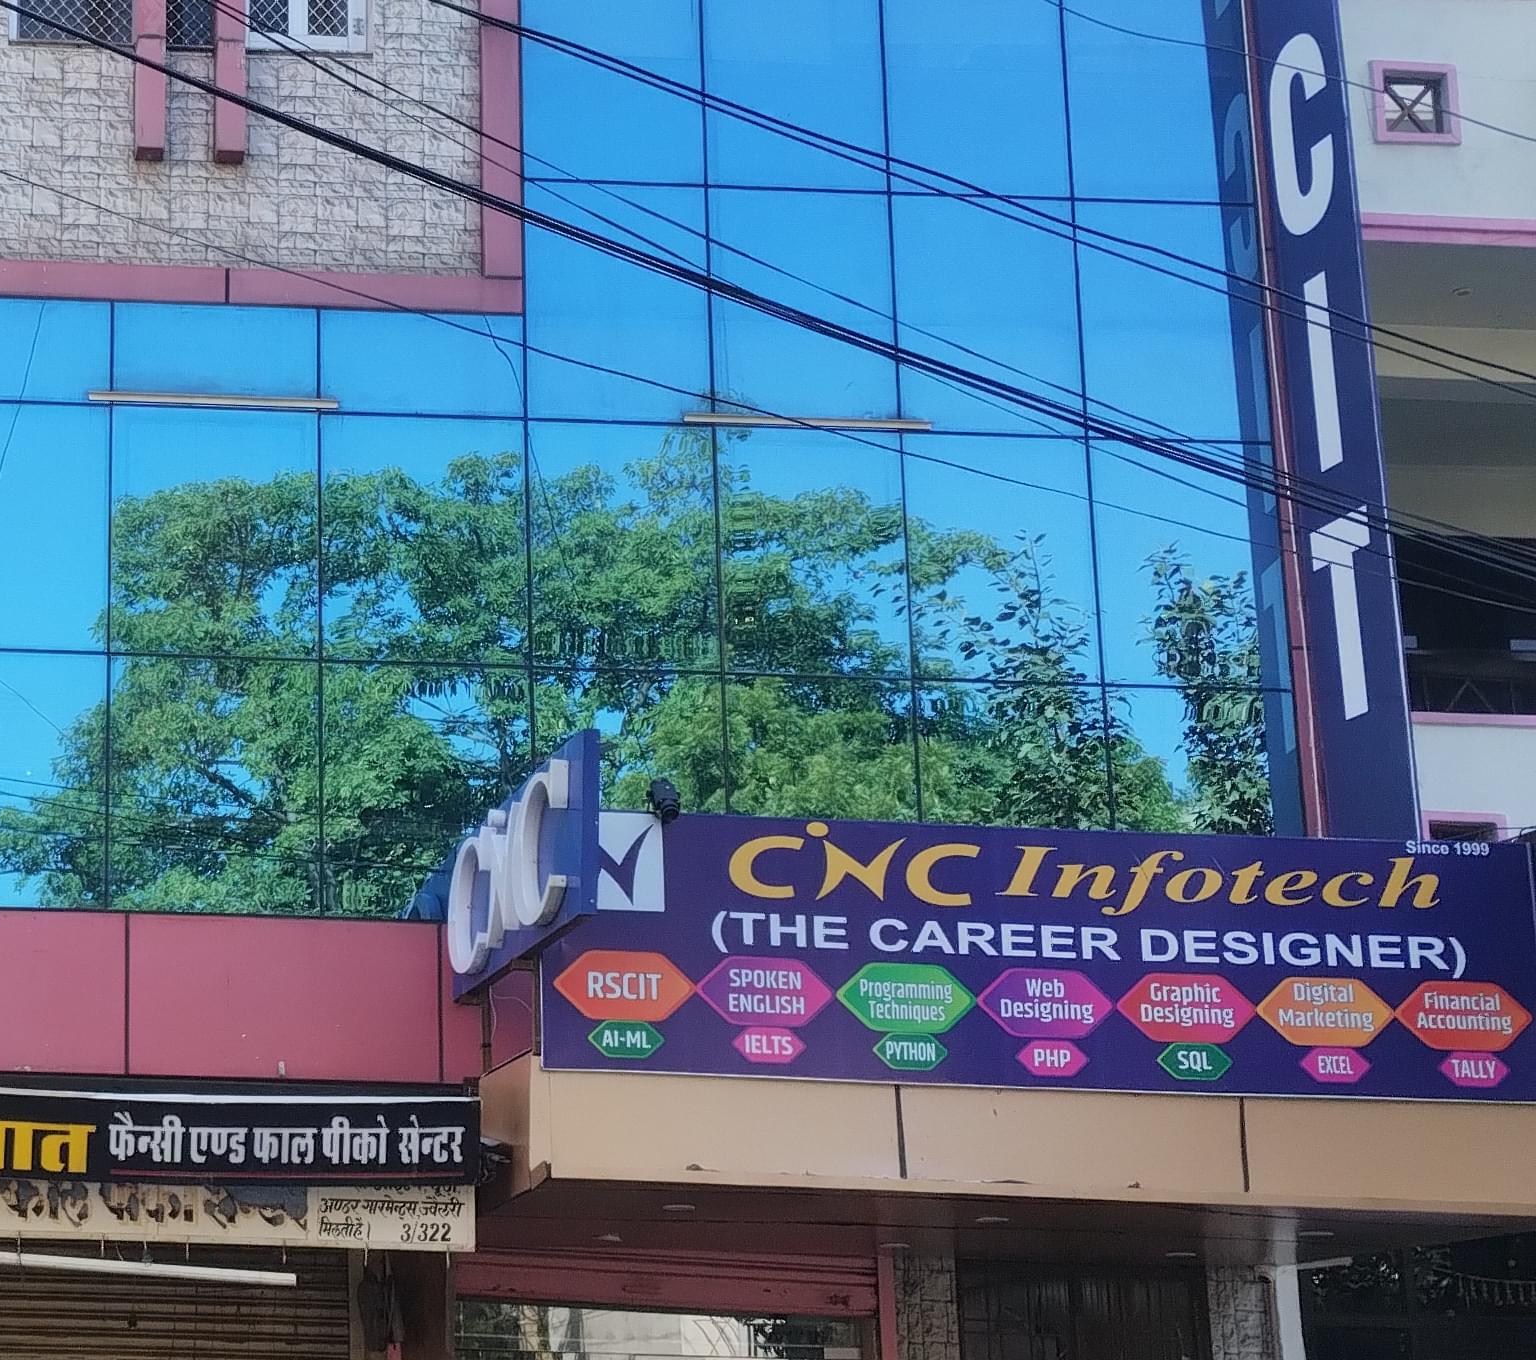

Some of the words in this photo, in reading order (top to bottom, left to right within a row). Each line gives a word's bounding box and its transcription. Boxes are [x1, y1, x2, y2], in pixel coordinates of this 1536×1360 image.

[1404, 838, 1450, 856] Since
[994, 844, 1442, 917] Infotech
[711, 910, 849, 953] (THE
[868, 917, 1121, 962] CAREER
[1139, 926, 1467, 979] DESIGNER)
[586, 970, 663, 1002] RSCIT
[729, 967, 803, 991] SPOKEN
[1024, 977, 1066, 998] Web
[859, 977, 953, 1007] Programming
[1148, 981, 1222, 1007] Graphic
[1293, 981, 1355, 1007] Digital
[1423, 990, 1501, 1013] Financial
[728, 992, 806, 1017] ENGLISH
[868, 1000, 947, 1024] Techniques
[999, 997, 1096, 1025] Designing
[1139, 1002, 1236, 1030] Designing
[1277, 1006, 1375, 1033] Marketing
[1415, 1010, 1513, 1035] Accounting
[600, 1028, 653, 1051] AI-ML
[743, 1034, 794, 1057] IELTS
[884, 1040, 937, 1063] PYTHON
[1032, 1048, 1072, 1070] PHP
[1175, 1050, 1214, 1073] SQL
[1316, 1054, 1356, 1076] EXCEL
[1449, 1058, 1499, 1081] TALLY
[188, 1126, 248, 1164] एण्ड
[252, 1126, 318, 1165] फाल
[399, 1222, 452, 1245] 3/322
